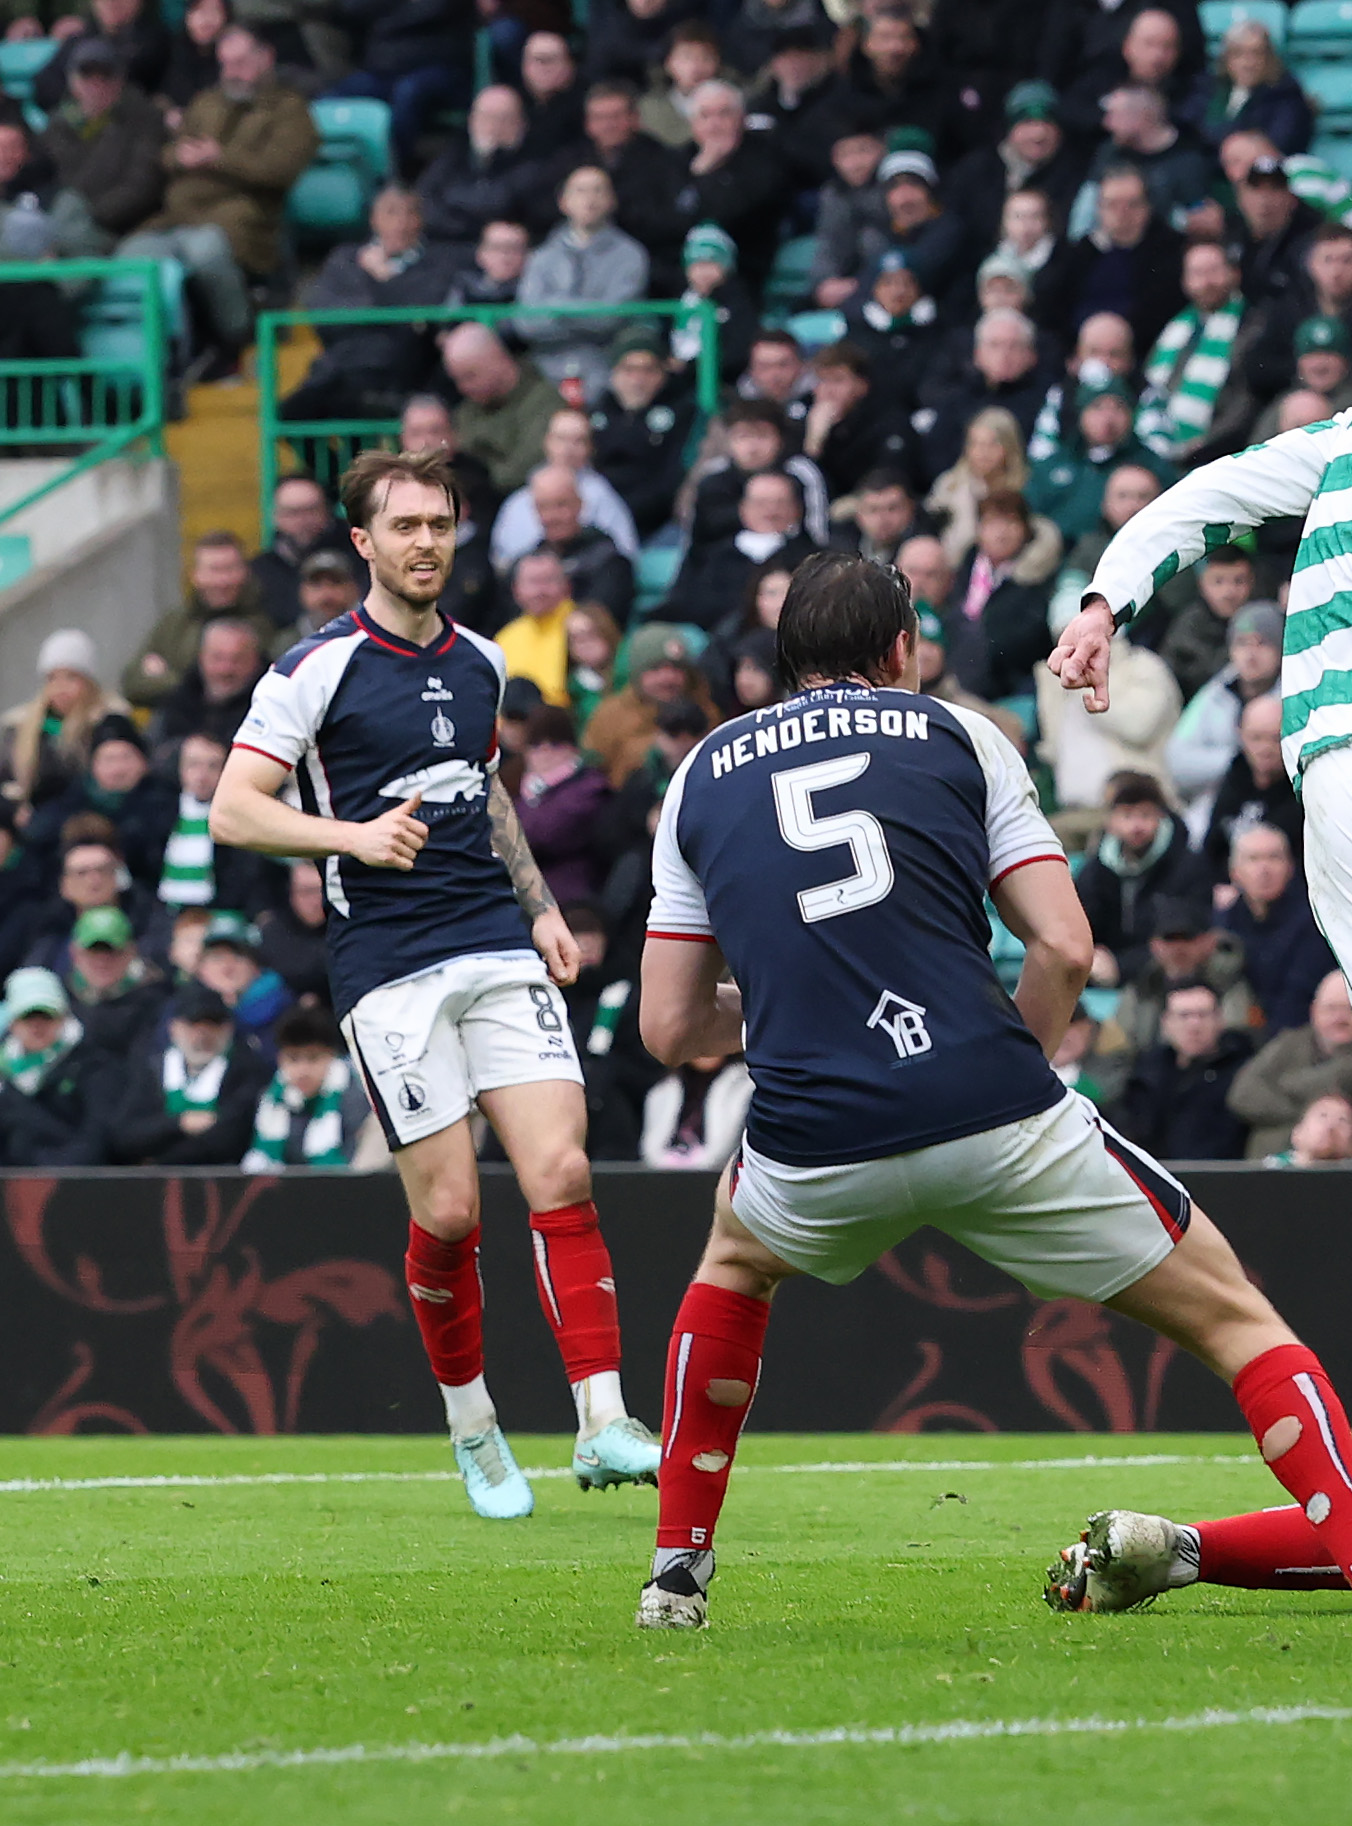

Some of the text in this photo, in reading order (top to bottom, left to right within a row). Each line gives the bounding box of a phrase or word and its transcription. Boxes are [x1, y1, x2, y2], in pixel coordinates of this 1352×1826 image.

[711, 707, 930, 780] HENDERSON
[771, 752, 895, 924] 5
[528, 985, 563, 1032] 8
